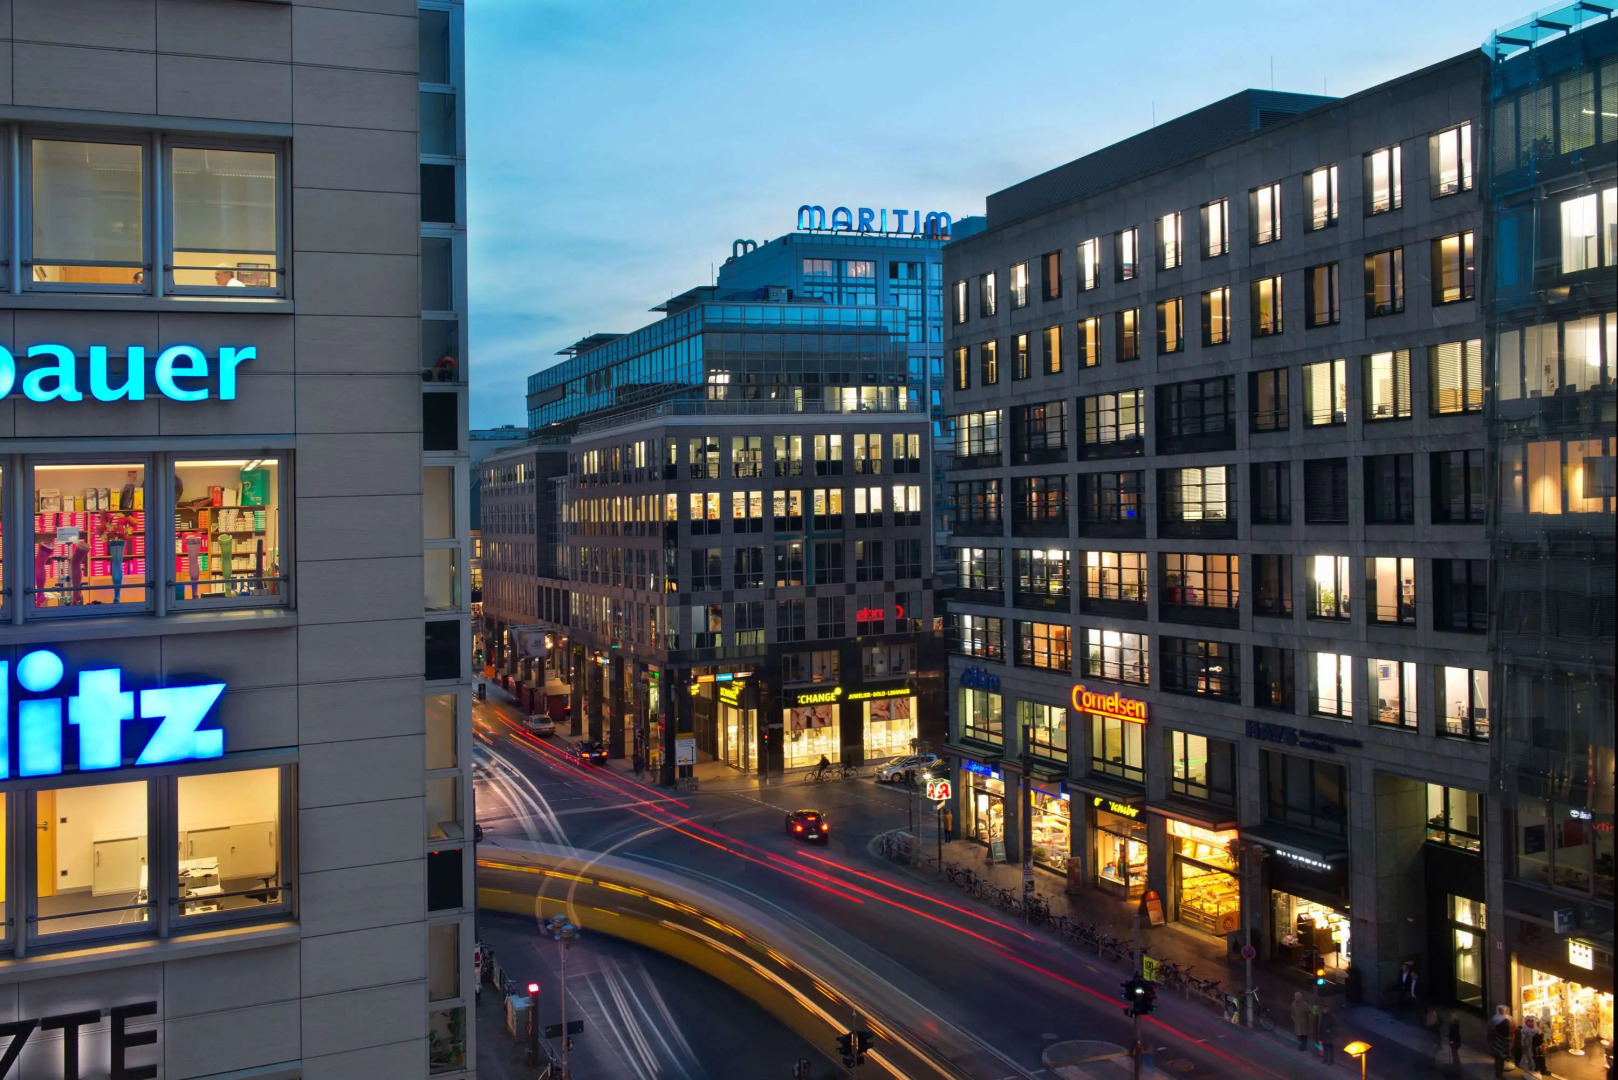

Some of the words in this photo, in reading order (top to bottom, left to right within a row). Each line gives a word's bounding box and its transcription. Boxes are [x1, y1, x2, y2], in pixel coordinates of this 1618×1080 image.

[797, 204, 952, 236] MARITIM
[0, 649, 227, 780] itz
[797, 692, 837, 704] CHANGE
[1072, 684, 1148, 719] Cornelsen
